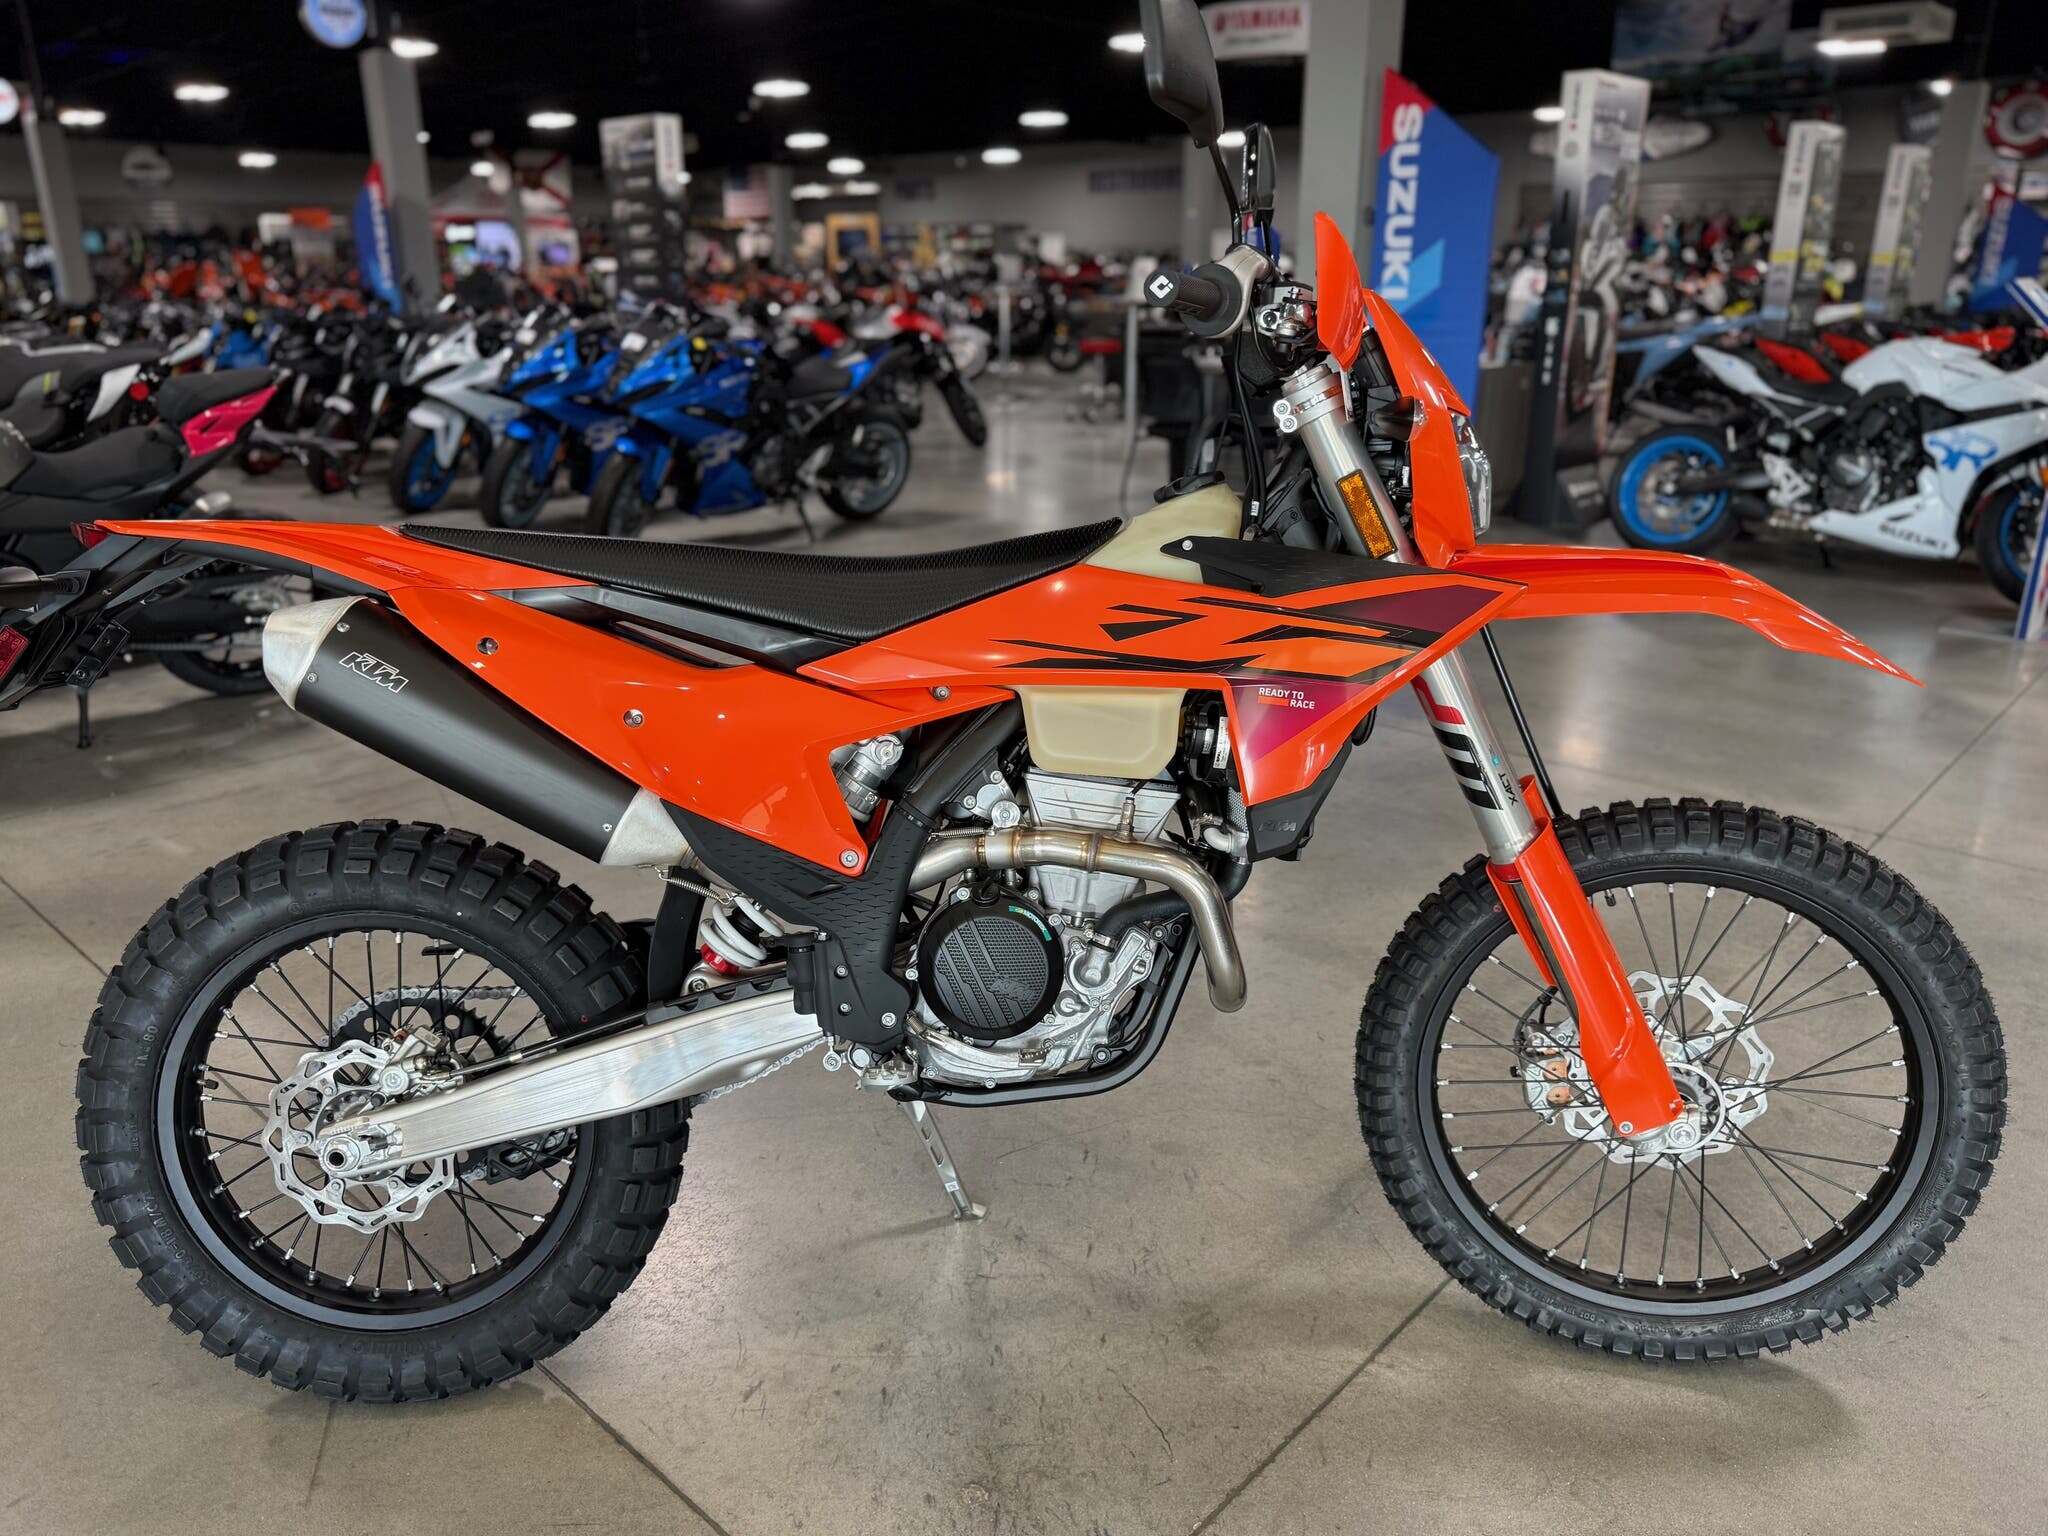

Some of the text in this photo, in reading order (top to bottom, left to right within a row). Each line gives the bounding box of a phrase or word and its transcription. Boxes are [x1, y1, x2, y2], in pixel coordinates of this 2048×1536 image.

[1380, 103, 1424, 300] SUZUKI
[339, 651, 409, 693] KTM
[1259, 687, 1304, 700] READY TO
[1290, 699, 1316, 709] RACE
[1498, 773, 1518, 806] XACT
